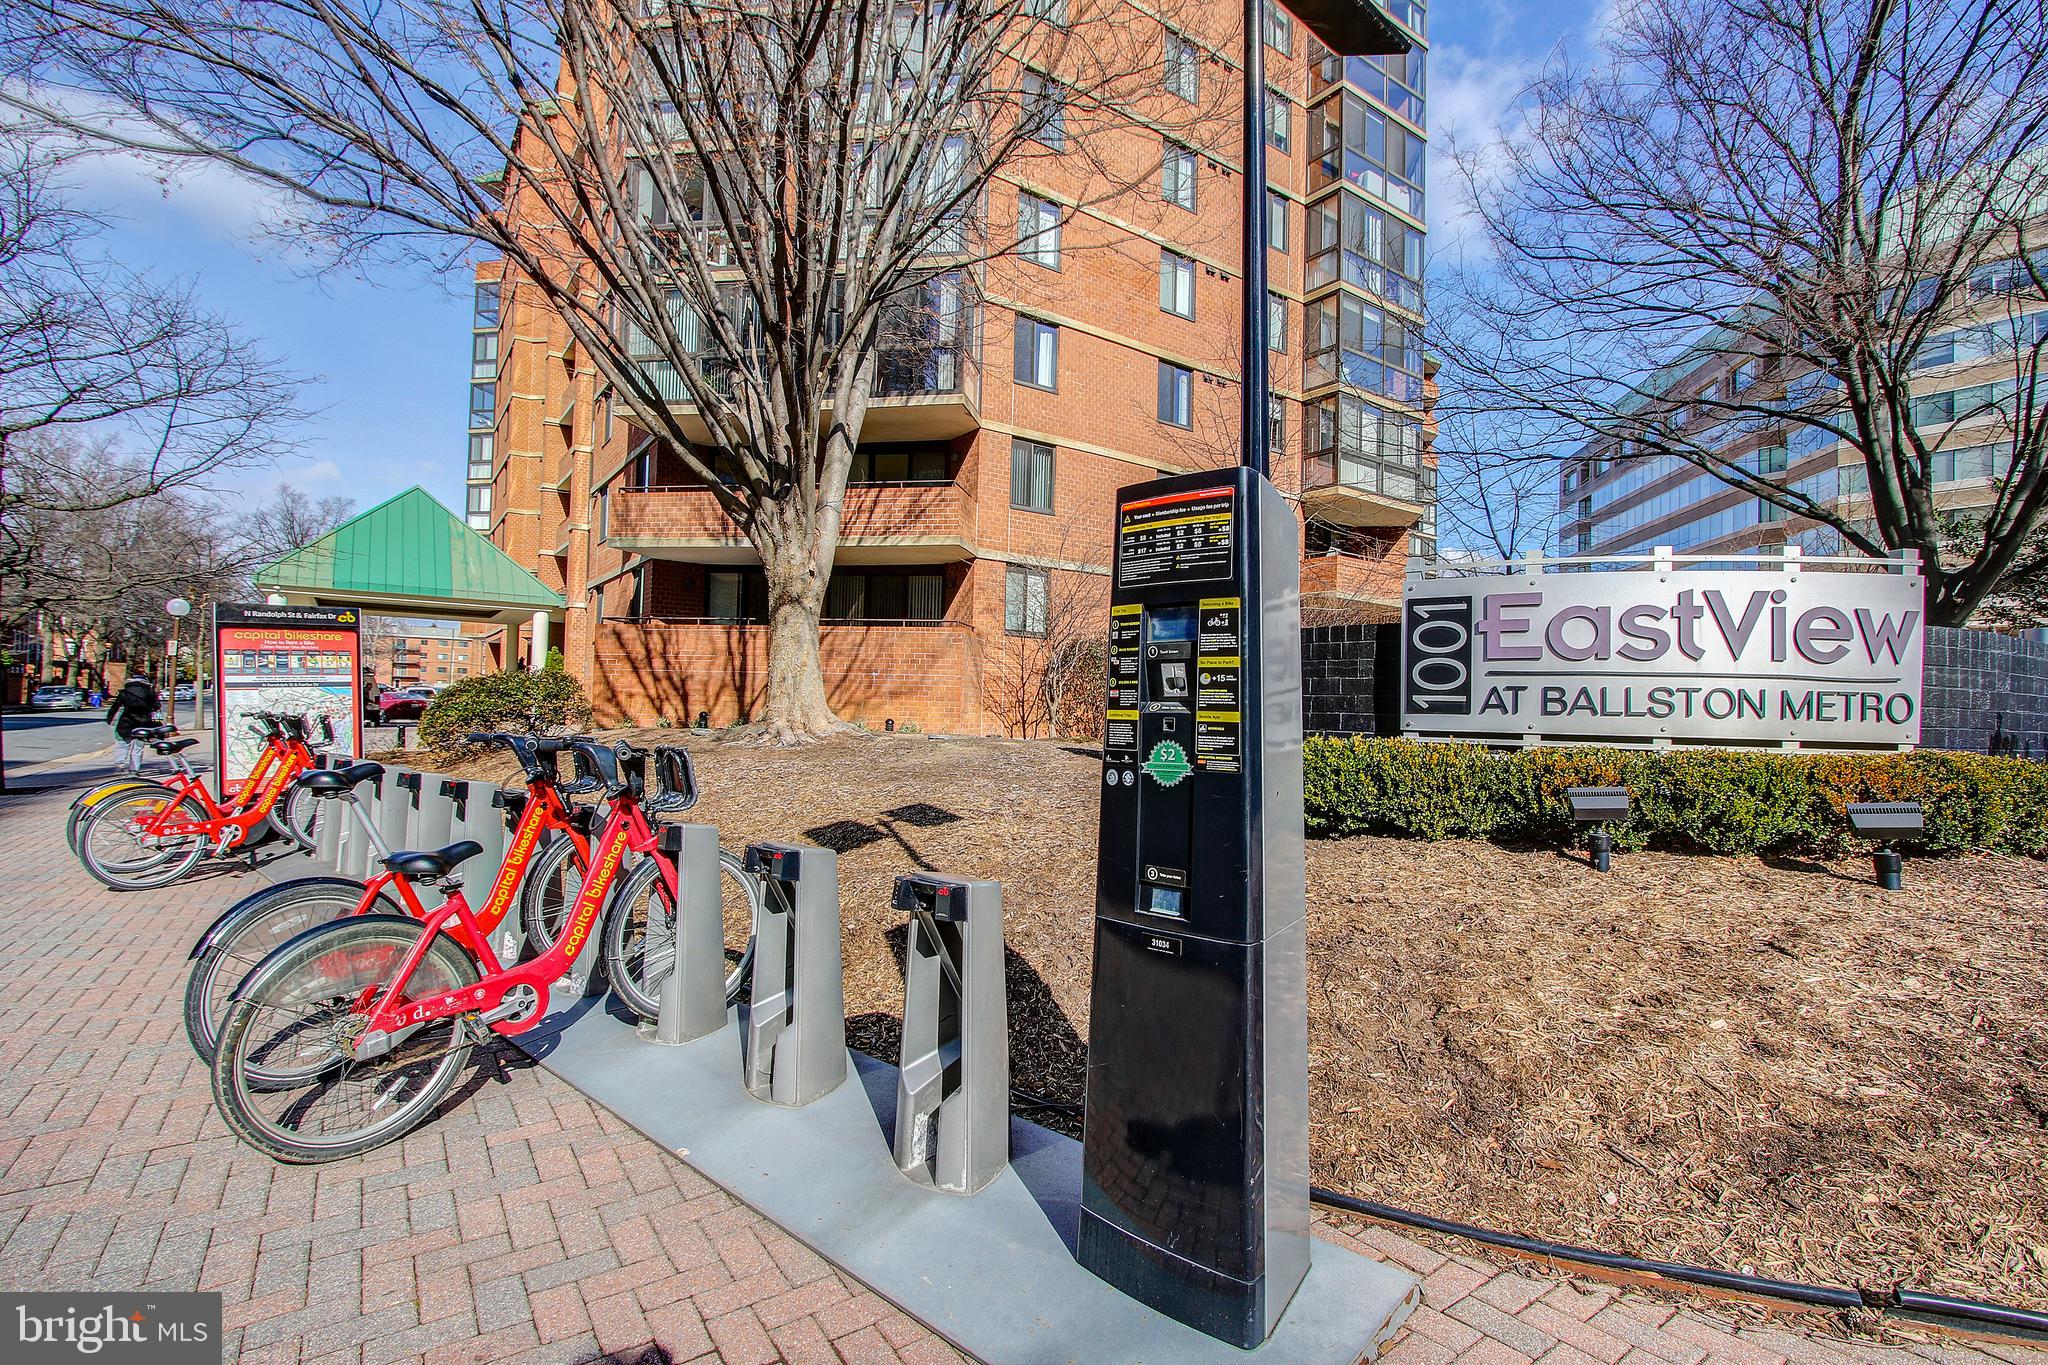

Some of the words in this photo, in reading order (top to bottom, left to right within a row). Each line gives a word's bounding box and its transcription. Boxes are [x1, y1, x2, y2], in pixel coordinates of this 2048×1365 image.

[252, 610, 287, 619] Randolph
[1474, 588, 1920, 666] EastView
[234, 631, 280, 641] capital
[284, 630, 342, 641] bikeshare
[1412, 594, 1468, 709] 1001
[1480, 686, 1528, 716] AT
[1541, 686, 1768, 720] BALLSTON
[1780, 690, 1914, 725] METRO
[1160, 748, 1176, 761] $2
[237, 780, 255, 804] capital
[260, 788, 278, 813] capital
[271, 754, 297, 786] bikeshare
[492, 868, 516, 916] capital
[507, 807, 544, 865] bikeshare
[565, 902, 595, 956] capital
[586, 832, 626, 898] bikeshare
[1152, 938, 1170, 948] 31034
